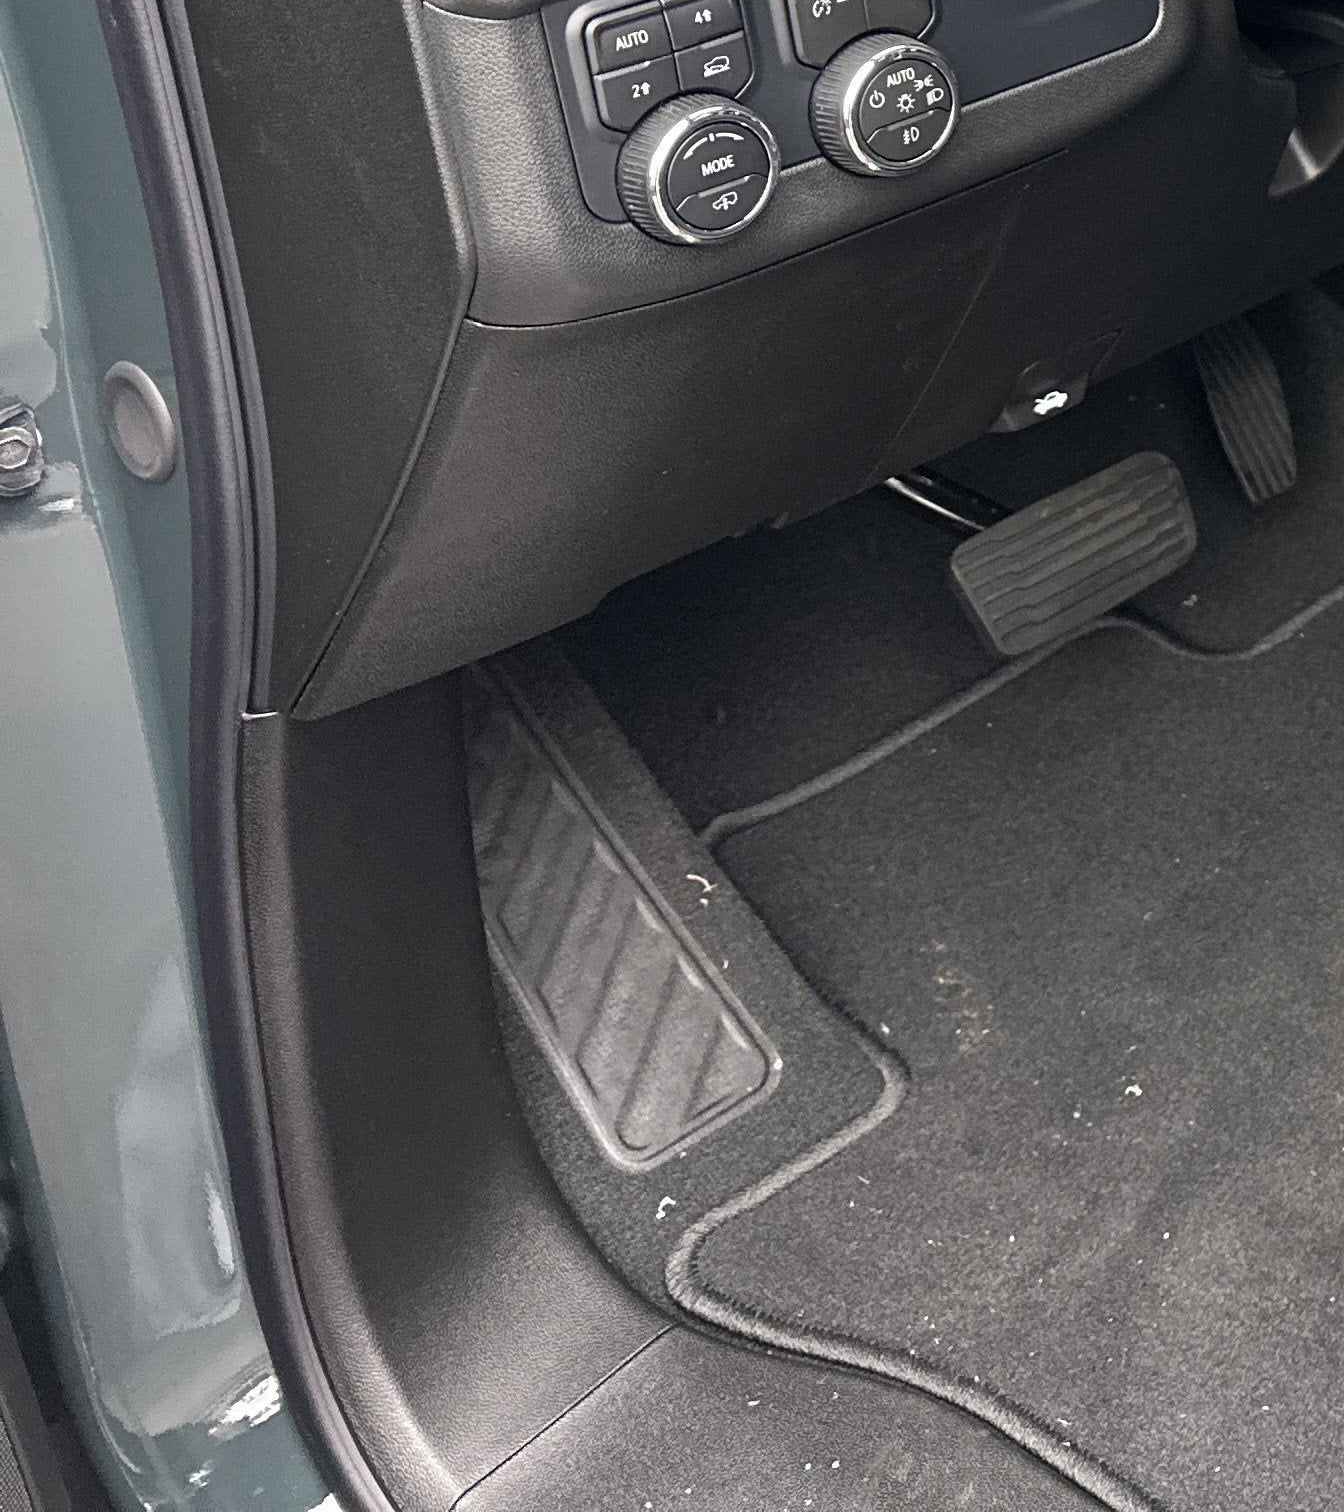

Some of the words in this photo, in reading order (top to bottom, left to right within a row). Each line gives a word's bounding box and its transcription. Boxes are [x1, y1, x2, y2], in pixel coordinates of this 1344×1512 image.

[615, 29, 649, 52] AUTO
[886, 67, 916, 88] AUTO
[701, 153, 735, 178] MODE
